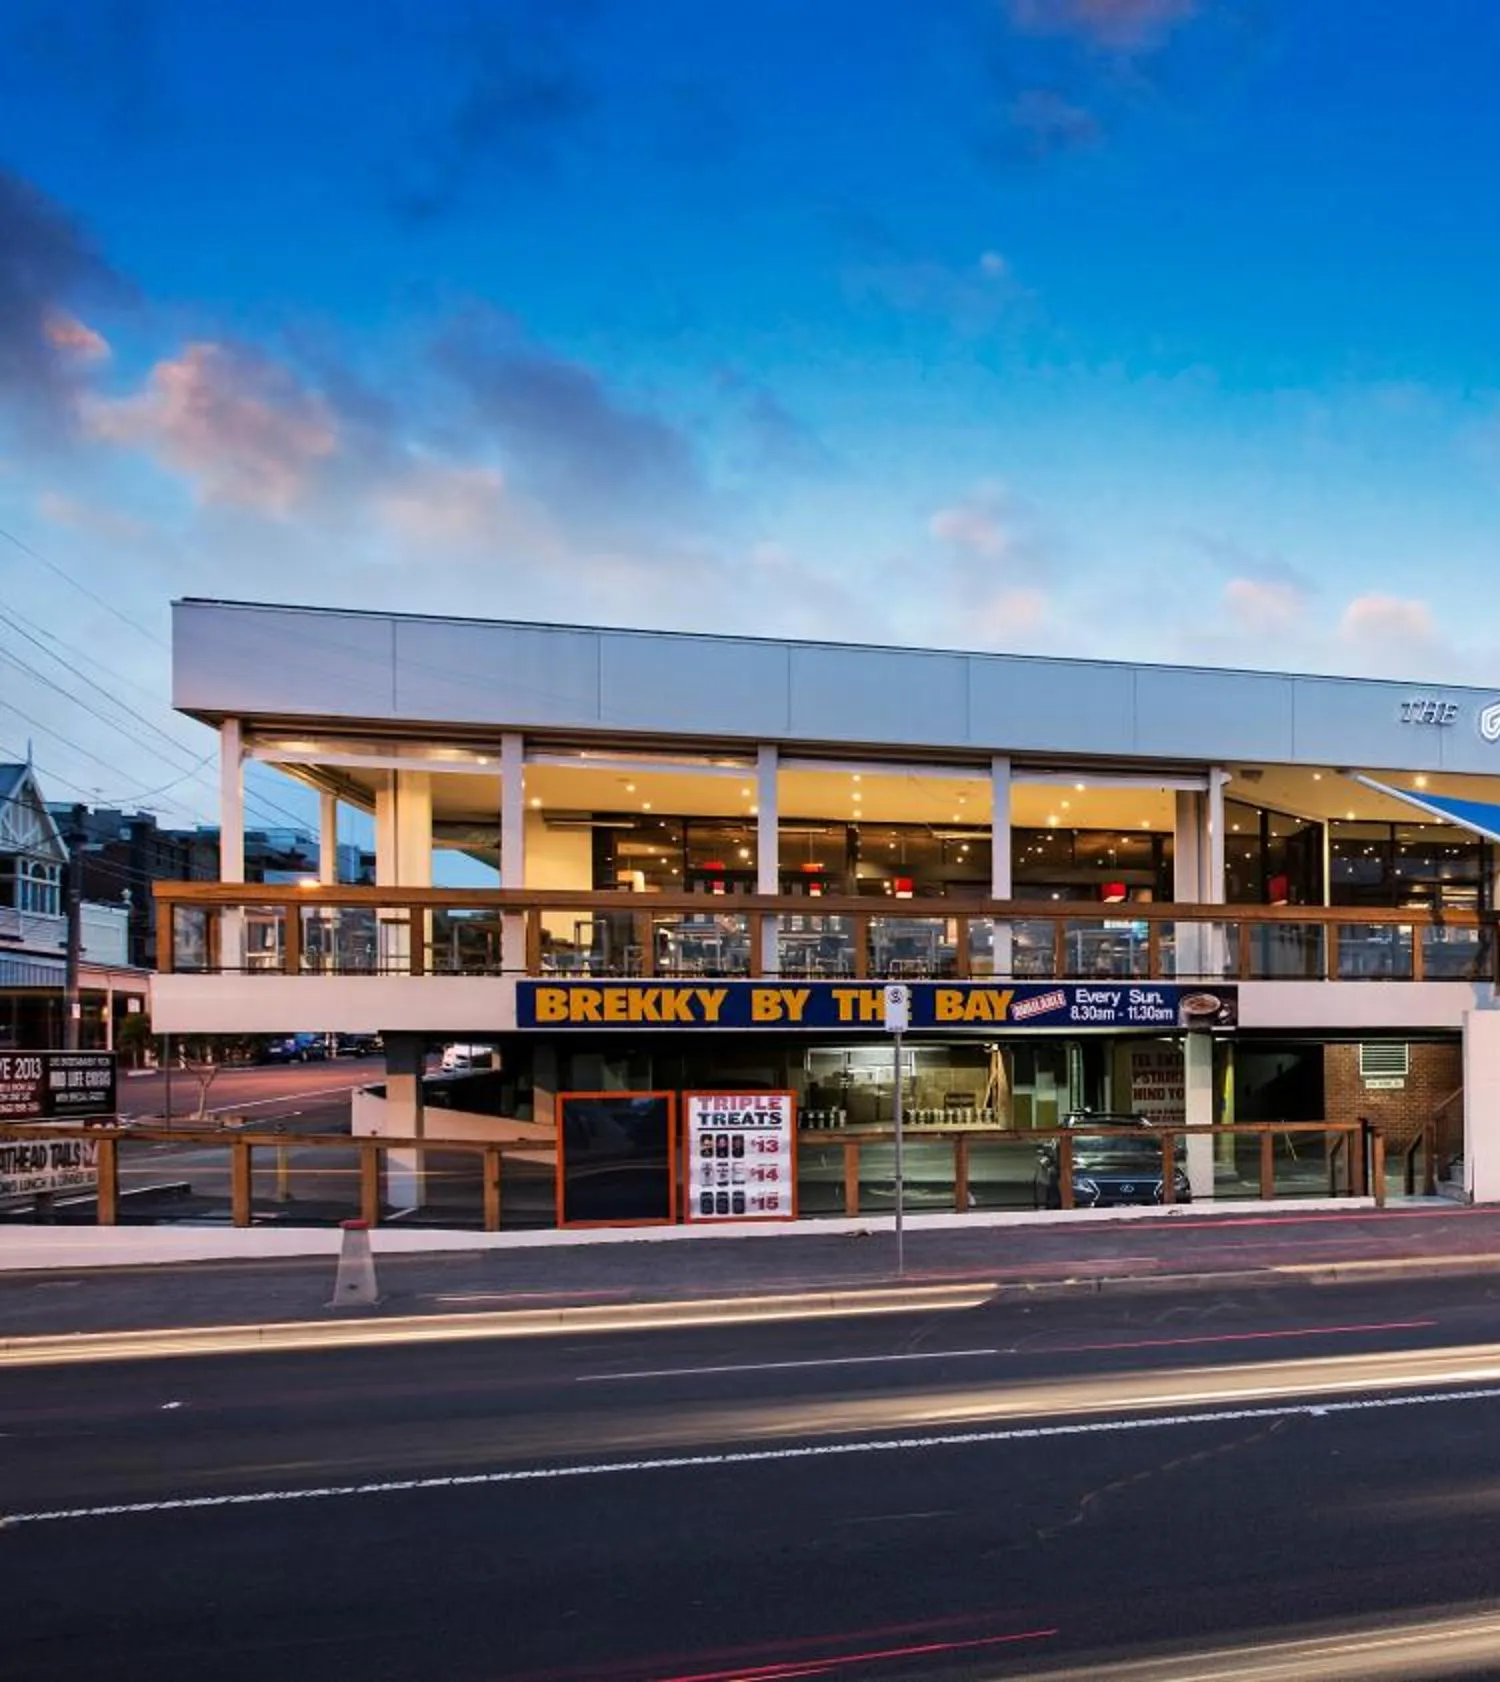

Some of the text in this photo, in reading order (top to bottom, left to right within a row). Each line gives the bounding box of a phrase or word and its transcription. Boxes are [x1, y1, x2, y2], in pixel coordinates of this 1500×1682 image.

[1400, 701, 1458, 727] THE
[535, 987, 1015, 1022] BREKKY BY TH BAY
[1075, 988, 1164, 1006] Every Sun.
[1070, 1004, 1115, 1021] 8.30am
[1128, 1004, 1174, 1021] 11.30am
[14, 1056, 41, 1080] 2013
[697, 1097, 783, 1111] TRIPLE
[697, 1111, 783, 1126] TREATS
[750, 1139, 779, 1153] $13
[49, 1142, 80, 1169] TAILS
[750, 1167, 779, 1182] $14
[750, 1196, 779, 1210] $15
